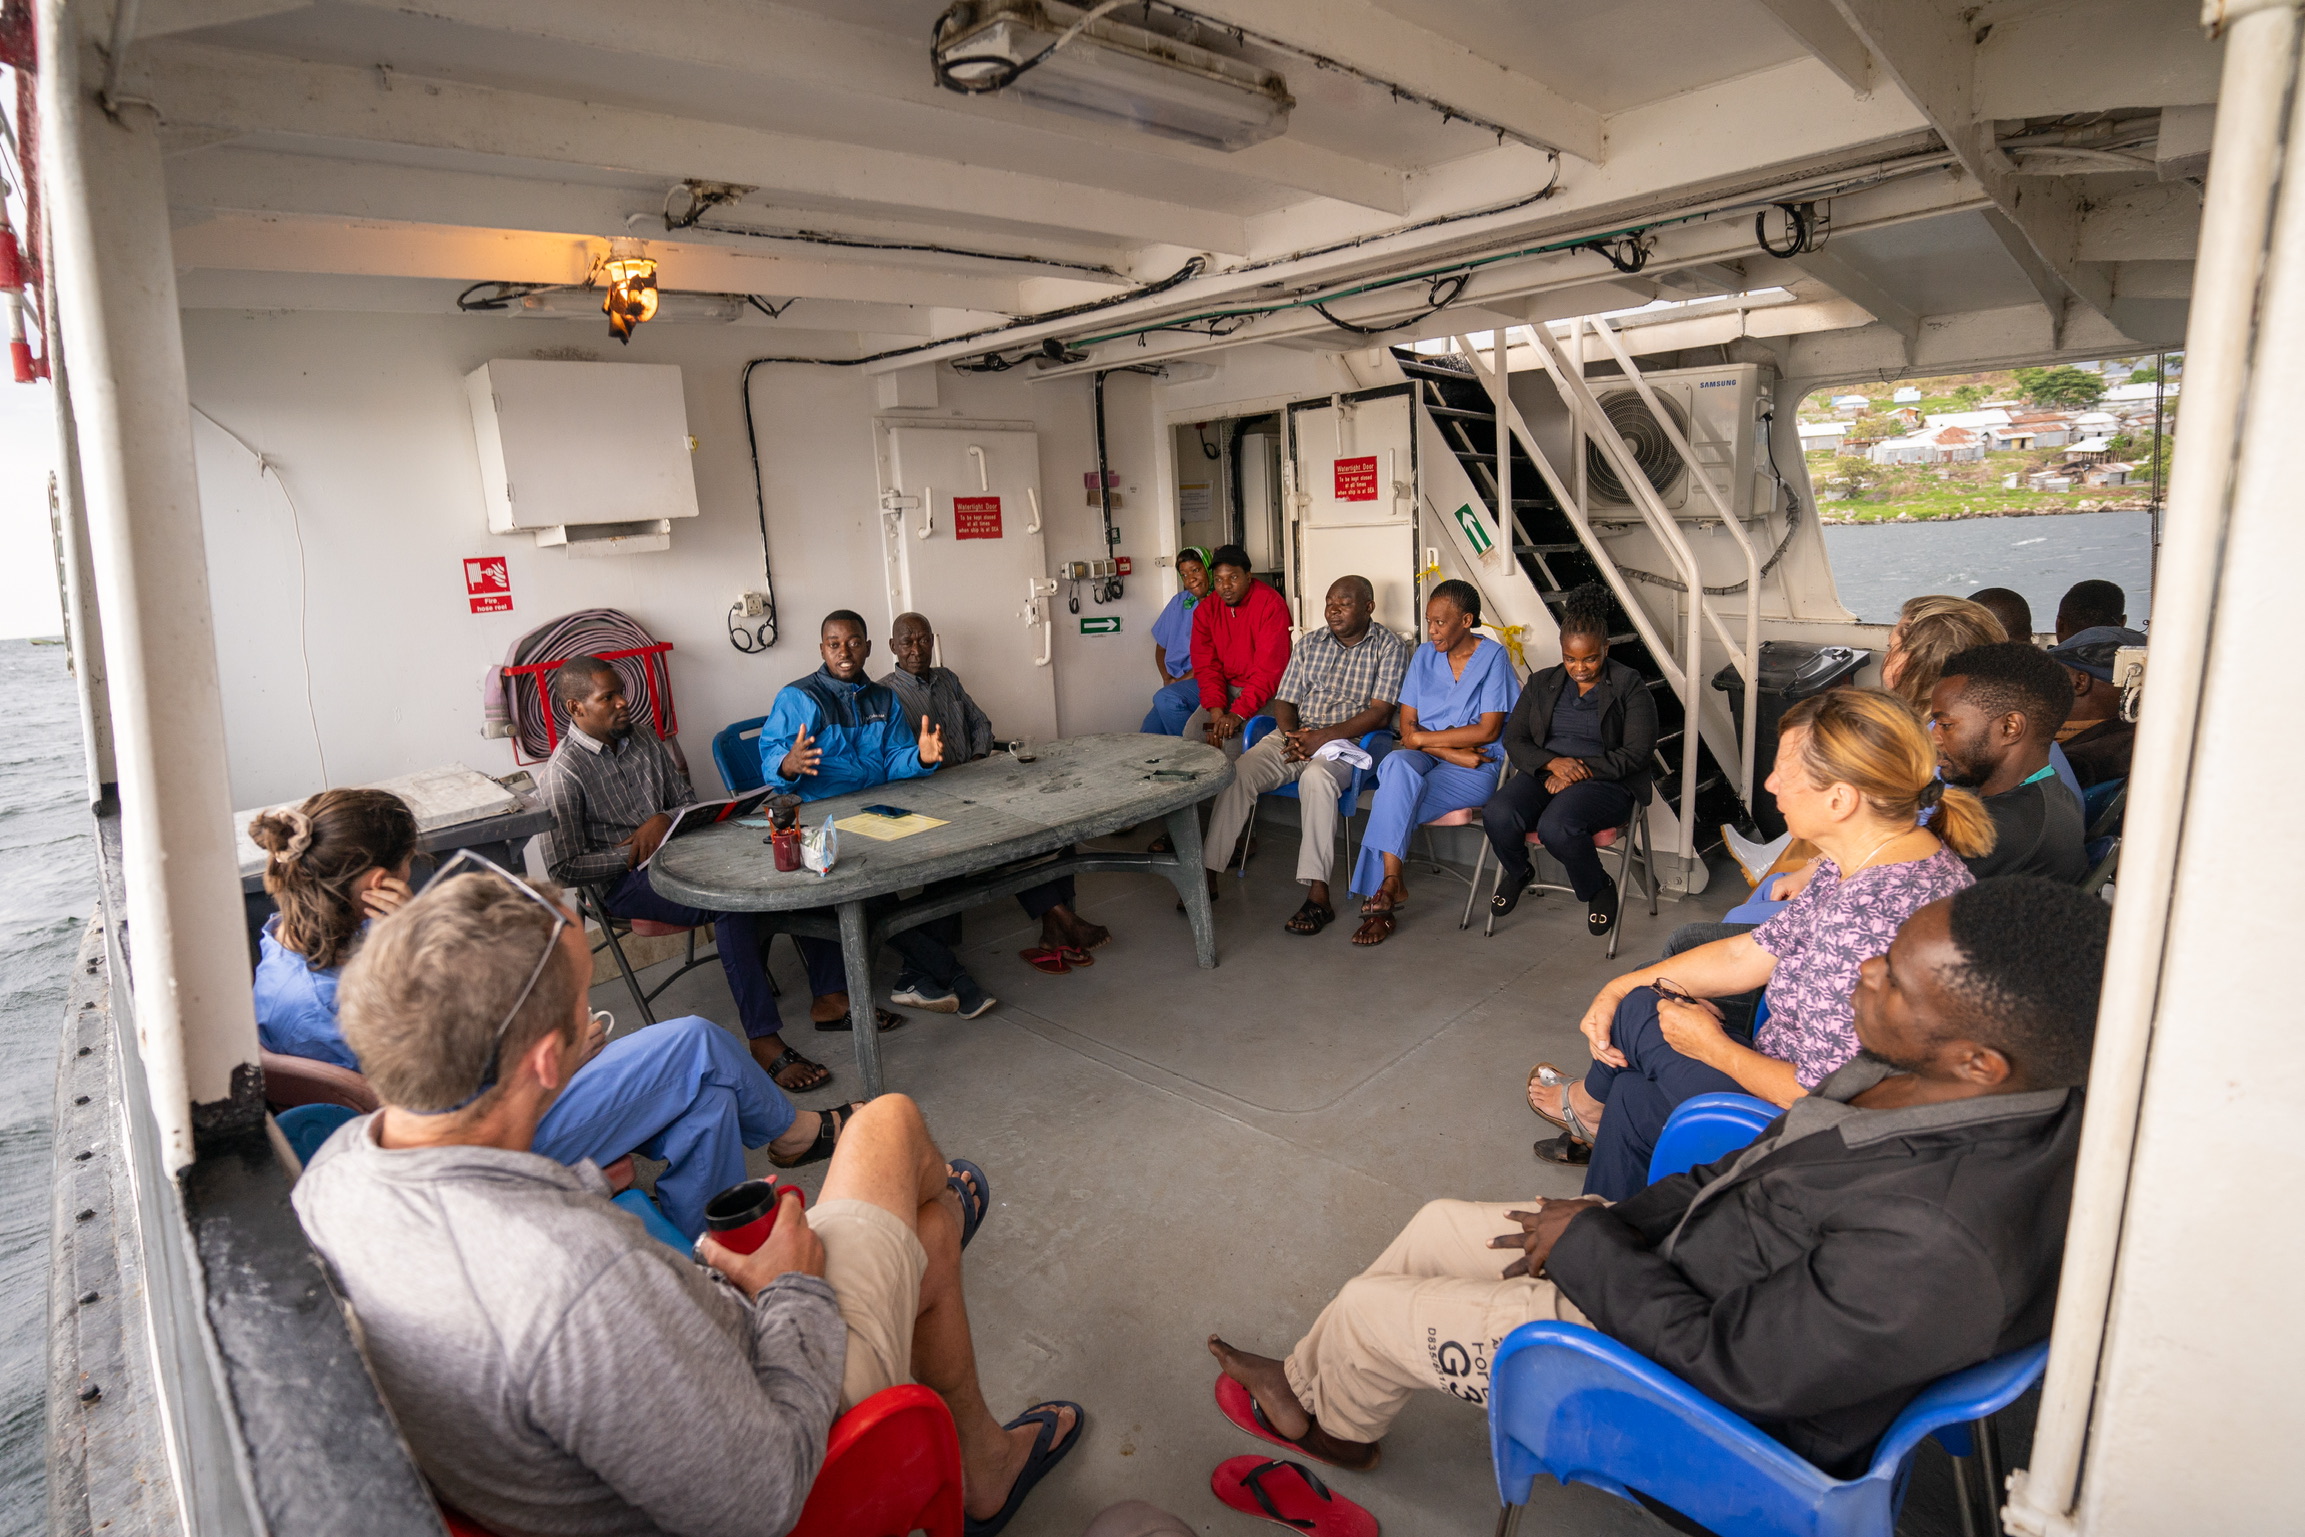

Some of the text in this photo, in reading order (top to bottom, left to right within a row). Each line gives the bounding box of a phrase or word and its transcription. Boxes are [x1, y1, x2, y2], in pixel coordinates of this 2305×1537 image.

[1700, 379, 1737, 388] SAMSUNG
[1337, 464, 1360, 472] Watertight
[957, 503, 983, 511] Watertight
